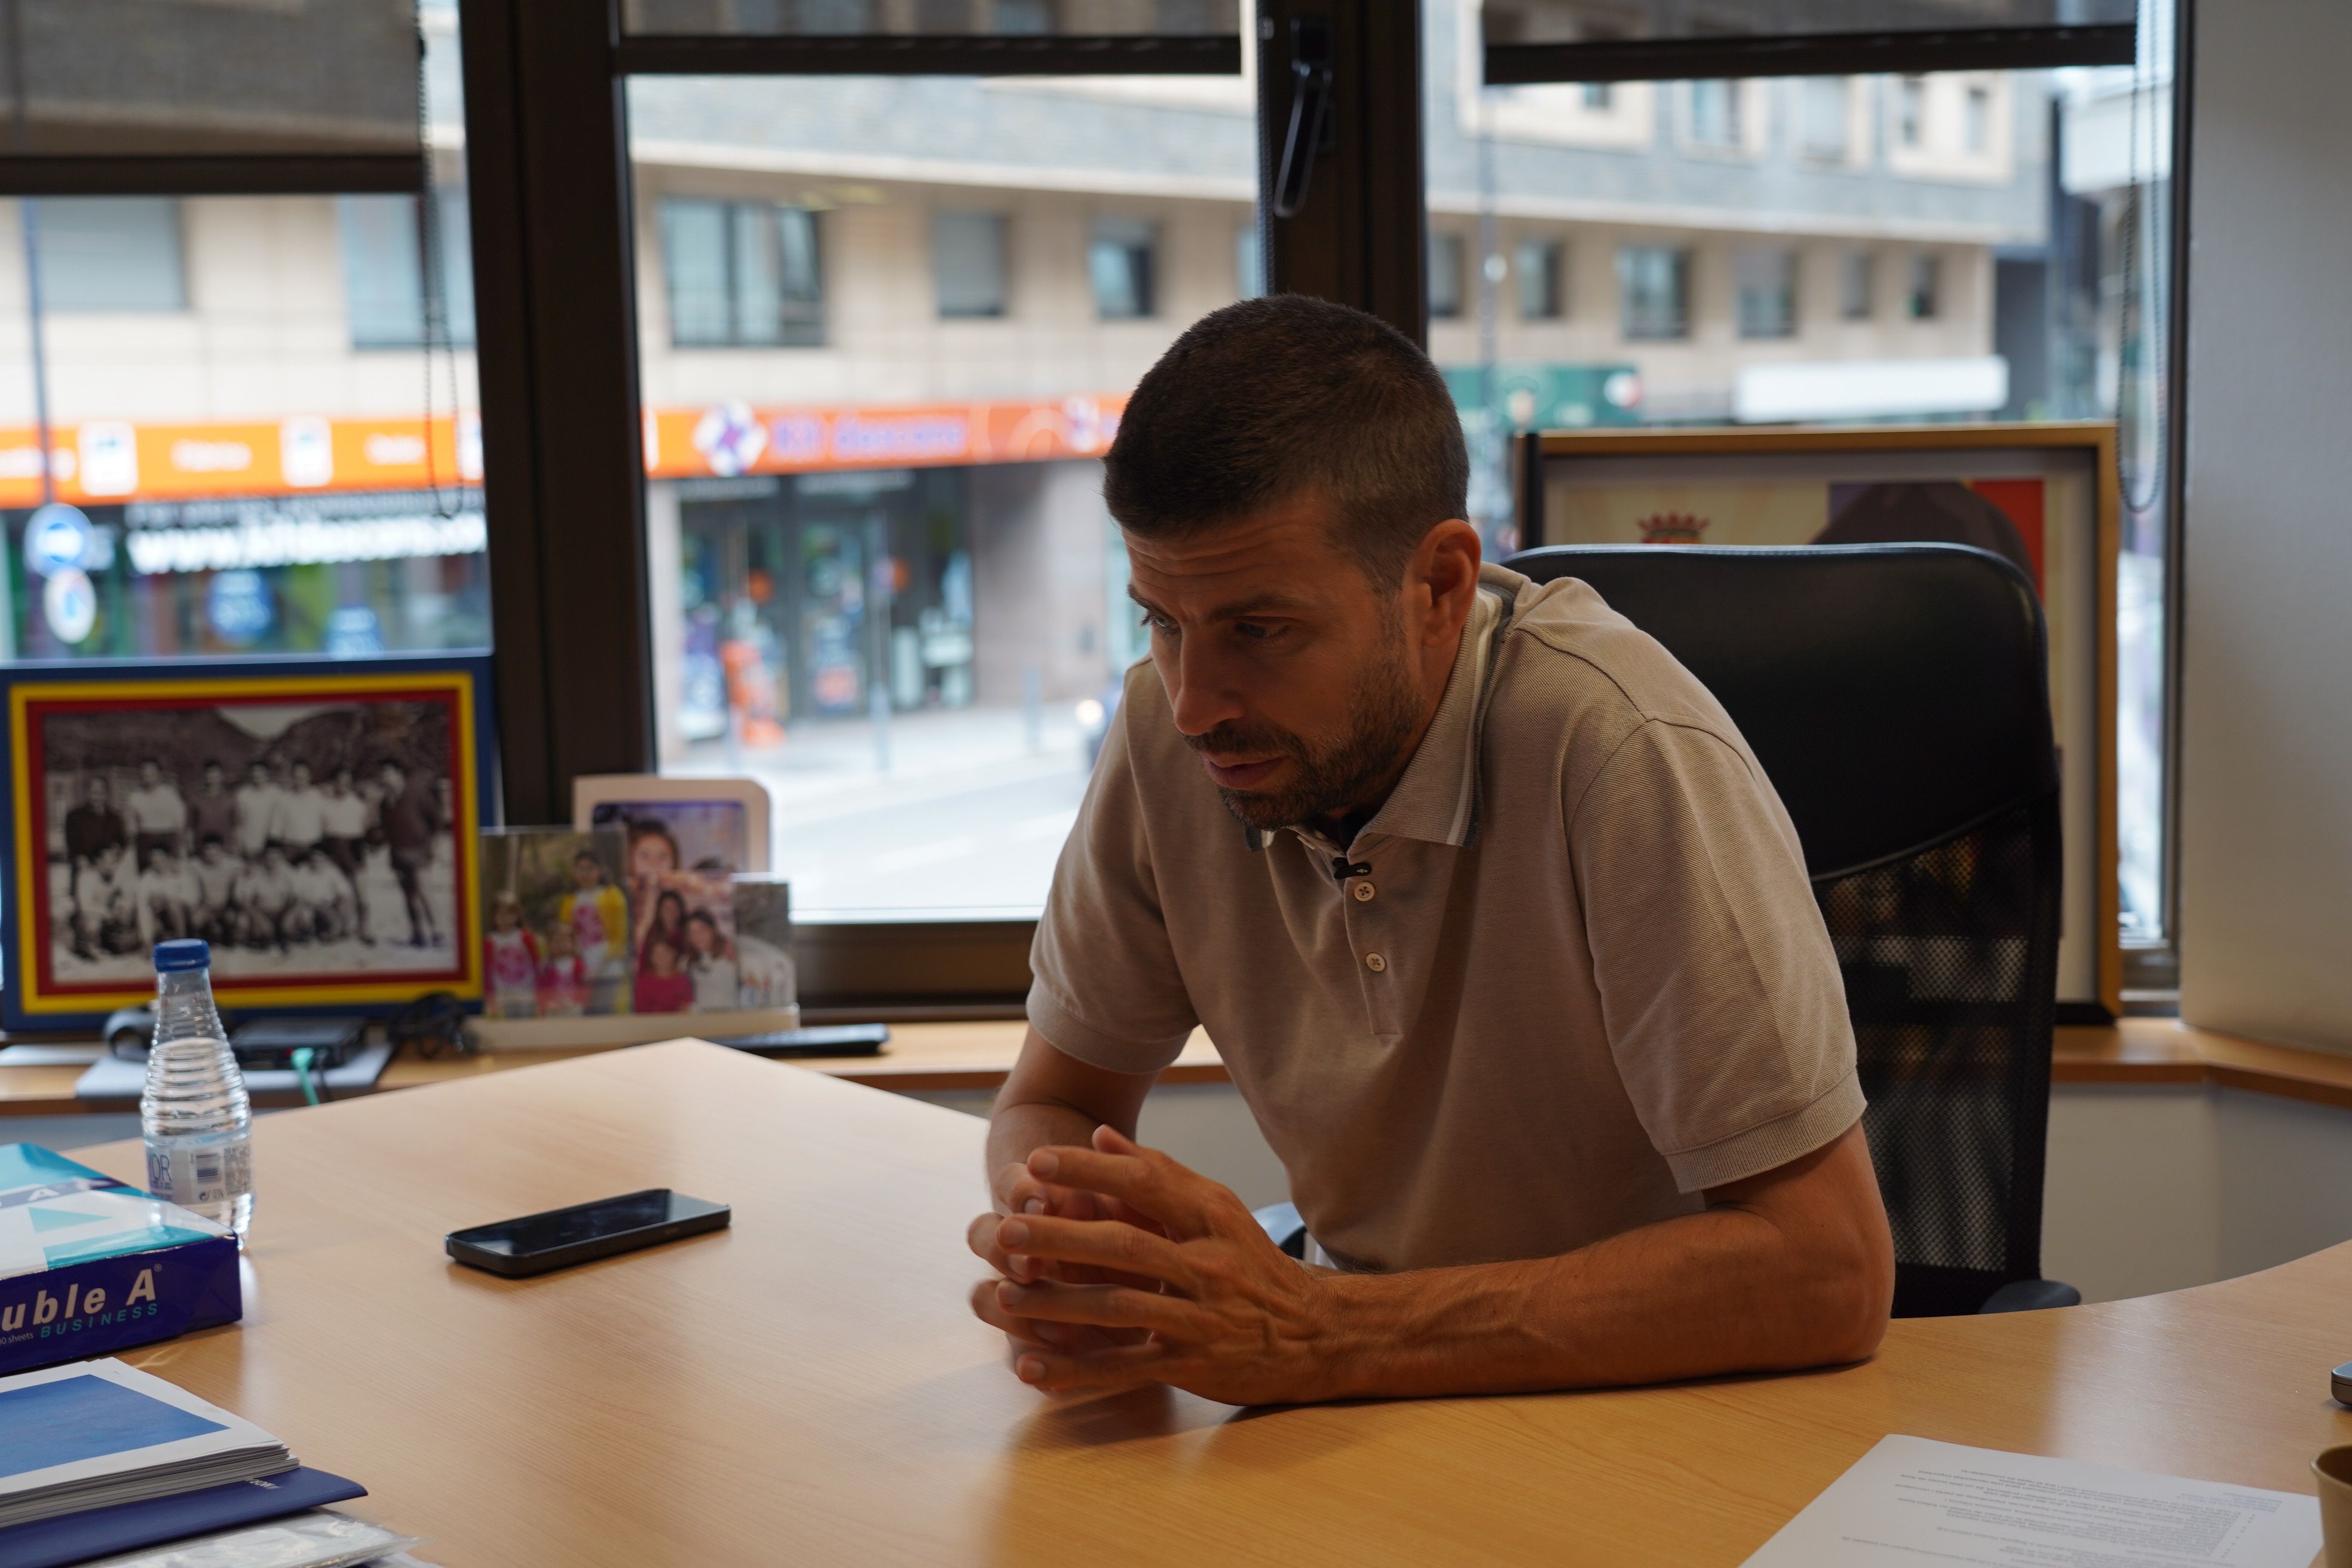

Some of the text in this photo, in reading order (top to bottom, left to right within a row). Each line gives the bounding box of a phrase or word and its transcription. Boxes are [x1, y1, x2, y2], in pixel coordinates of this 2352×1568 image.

[41, 1303, 157, 1339] BUSINESS
[0, 1333, 33, 1345] 0 sheets
